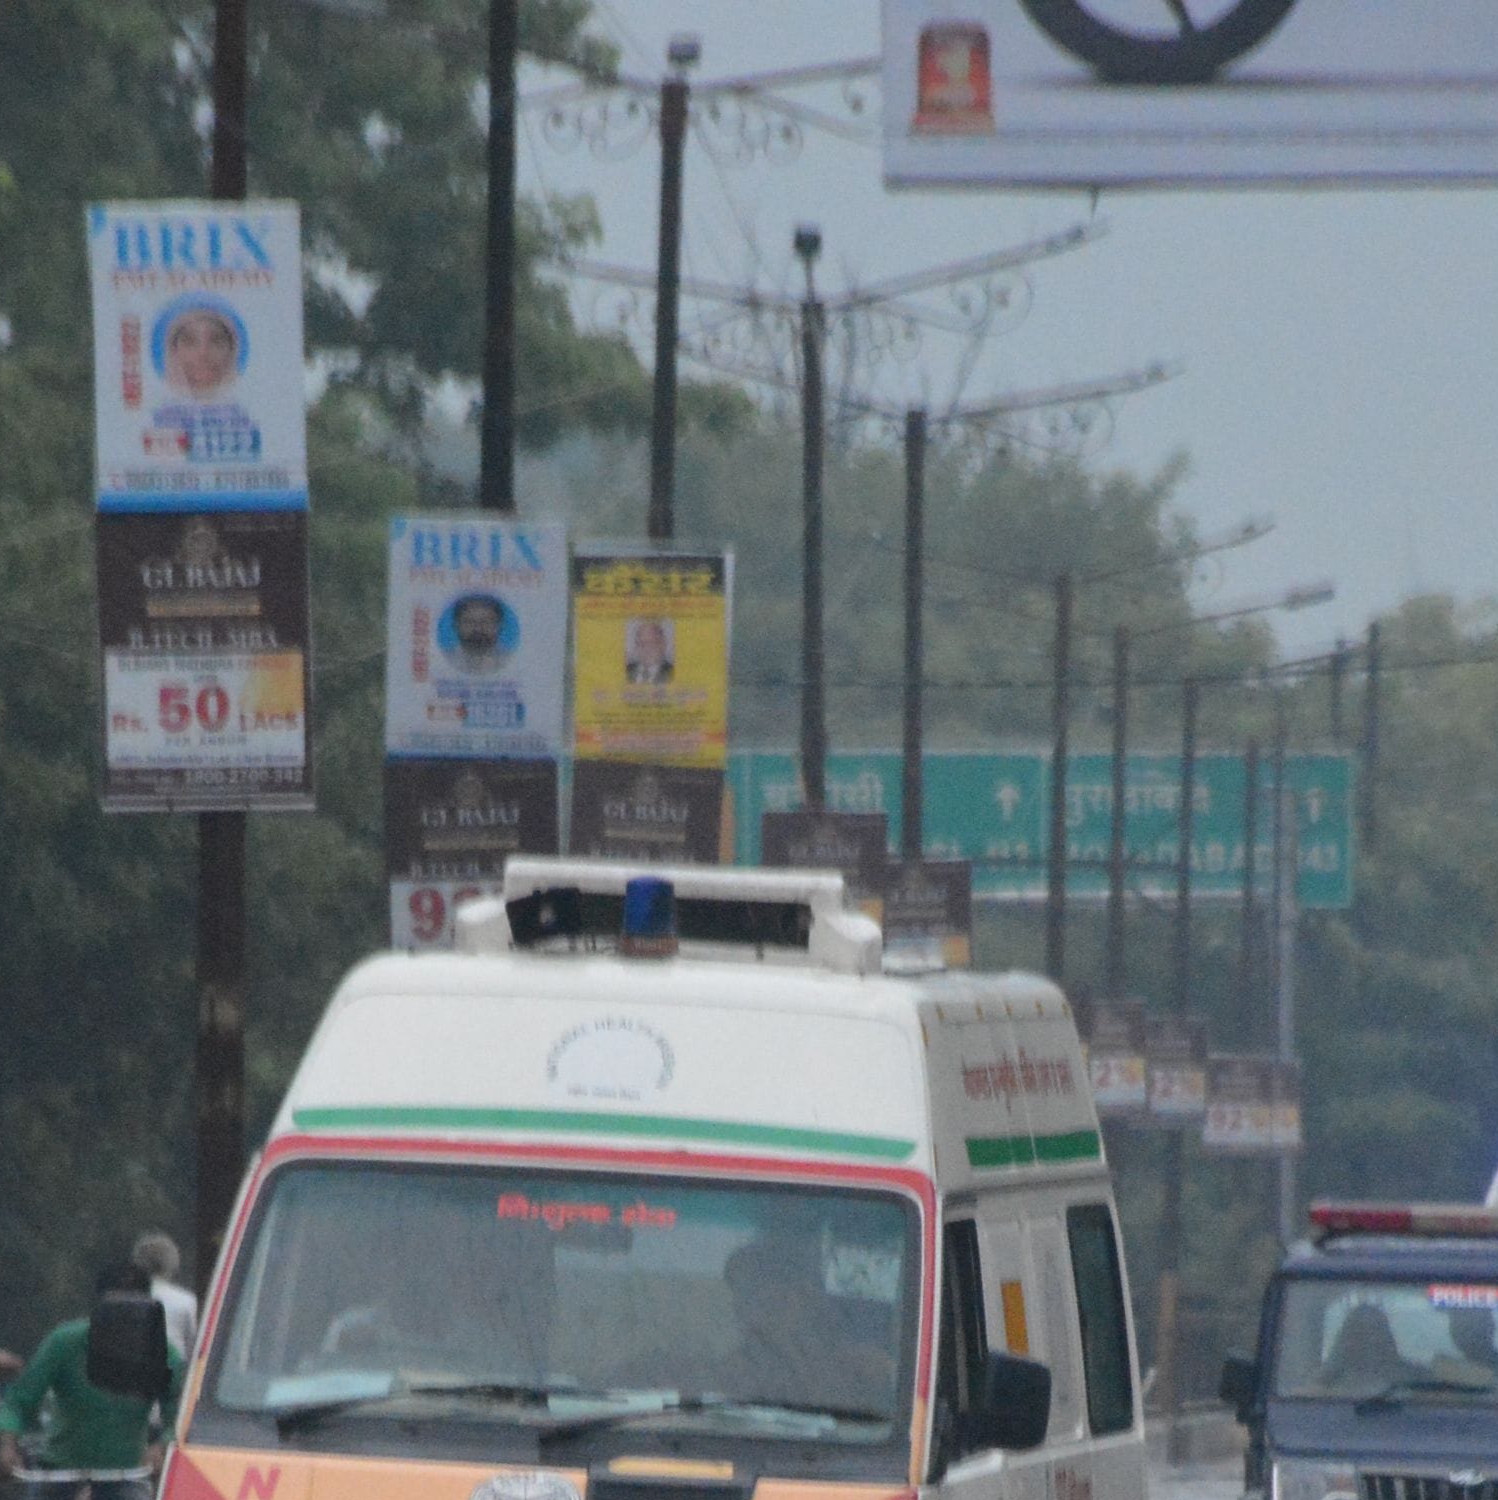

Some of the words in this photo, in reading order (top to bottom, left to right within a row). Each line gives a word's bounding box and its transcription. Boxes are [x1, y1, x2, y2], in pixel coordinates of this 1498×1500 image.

[113, 221, 275, 268] BRIX
[410, 529, 545, 570] BRIX
[185, 556, 262, 589] BAJAJ
[158, 684, 230, 734] 50
